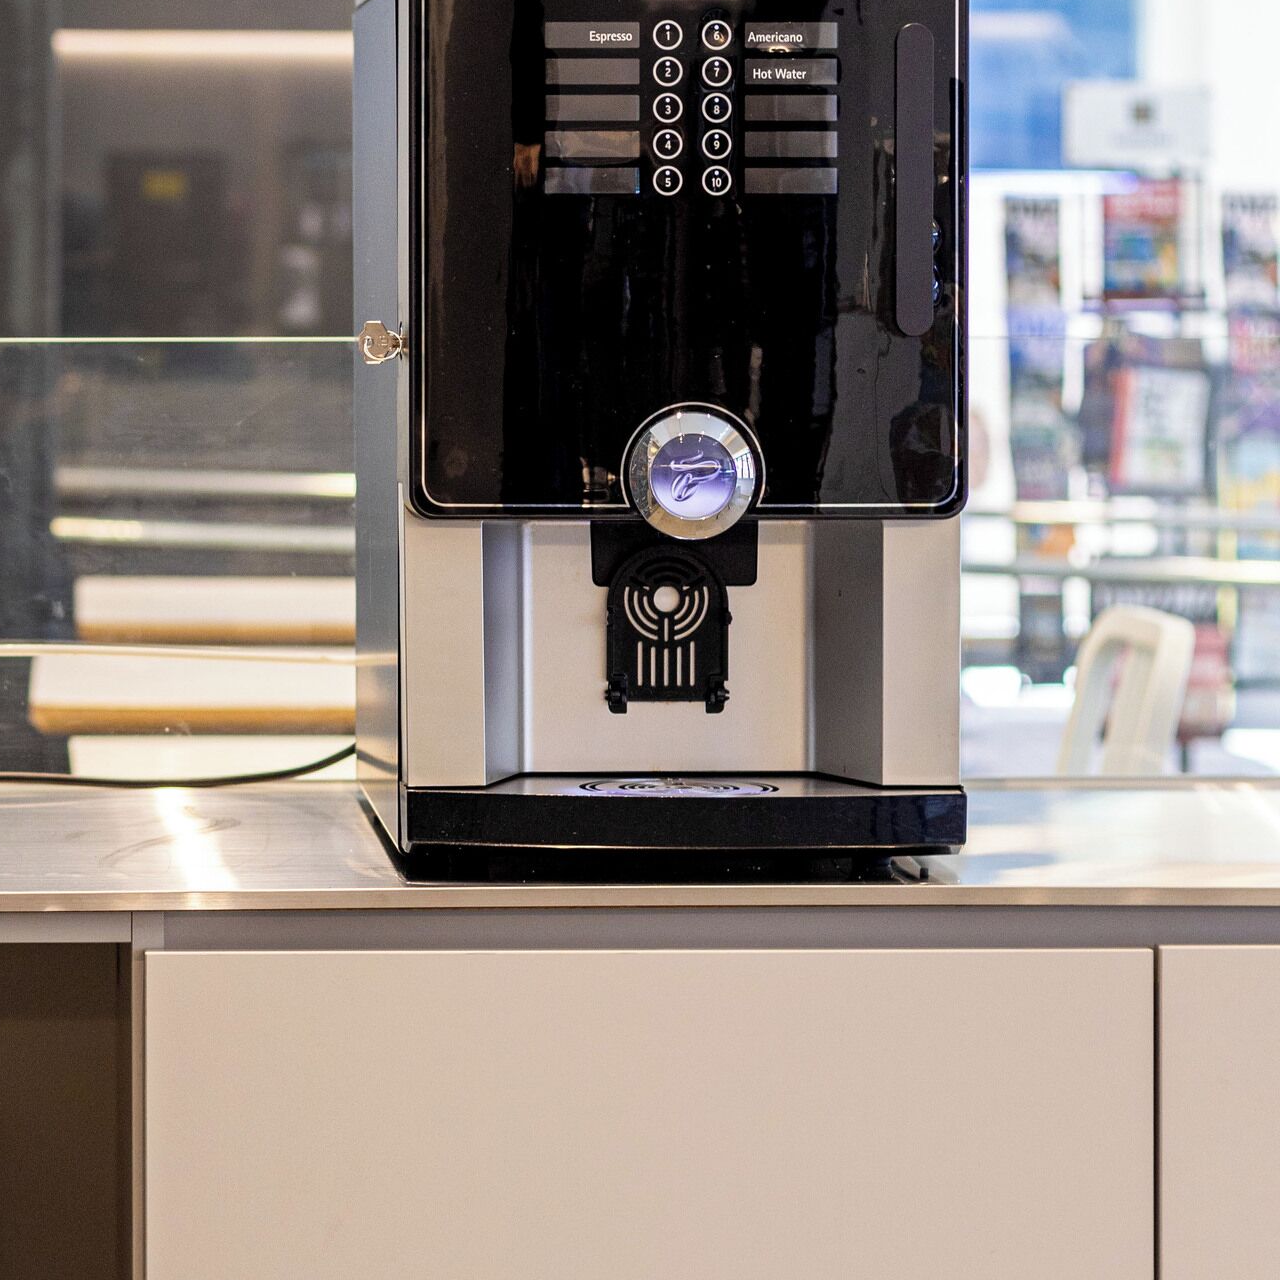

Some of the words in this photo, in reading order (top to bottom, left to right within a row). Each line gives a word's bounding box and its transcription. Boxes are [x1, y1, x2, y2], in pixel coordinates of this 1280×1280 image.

[589, 30, 633, 44] Espresso
[665, 30, 671, 41] 1
[713, 30, 720, 41] 6
[748, 31, 803, 44] Americano
[664, 67, 672, 78] 2
[714, 67, 720, 78] 7
[752, 68, 772, 80] Hot
[773, 68, 806, 80] Water
[664, 104, 672, 115] 3
[713, 104, 720, 115] 8
[664, 140, 672, 151] 4
[713, 140, 720, 150] 9
[664, 176, 672, 188] 5
[712, 176, 722, 188] 10
